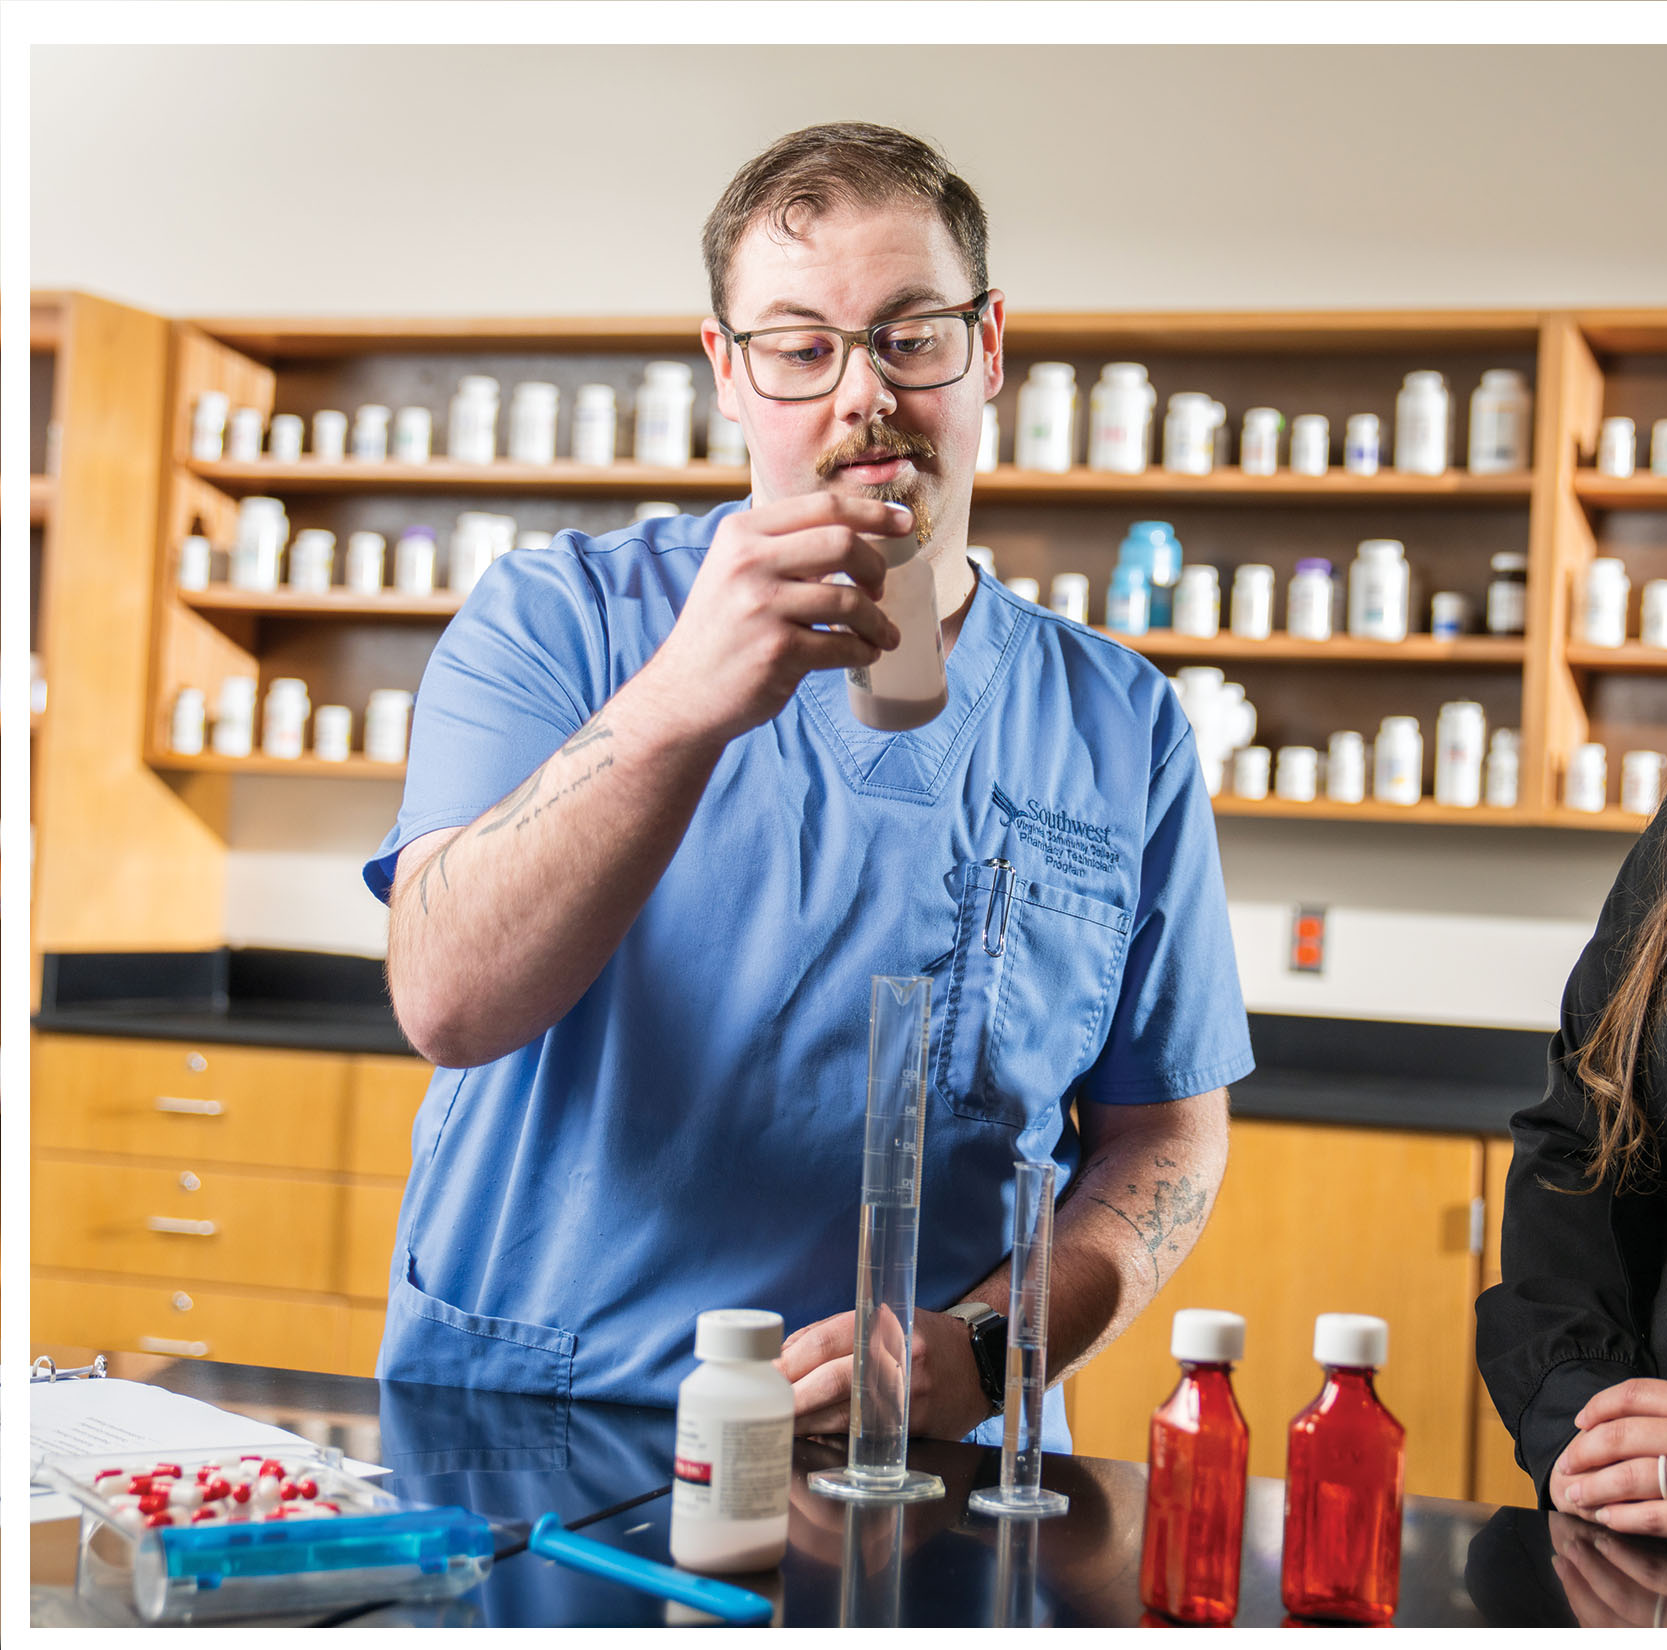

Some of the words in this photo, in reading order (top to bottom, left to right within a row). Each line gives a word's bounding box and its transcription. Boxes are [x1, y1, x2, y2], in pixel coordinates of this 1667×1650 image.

[1027, 799, 1111, 846] Southwest
[1020, 832, 1064, 858] Pharmacy
[1067, 849, 1113, 874] Technician
[1046, 856, 1085, 877] Program
